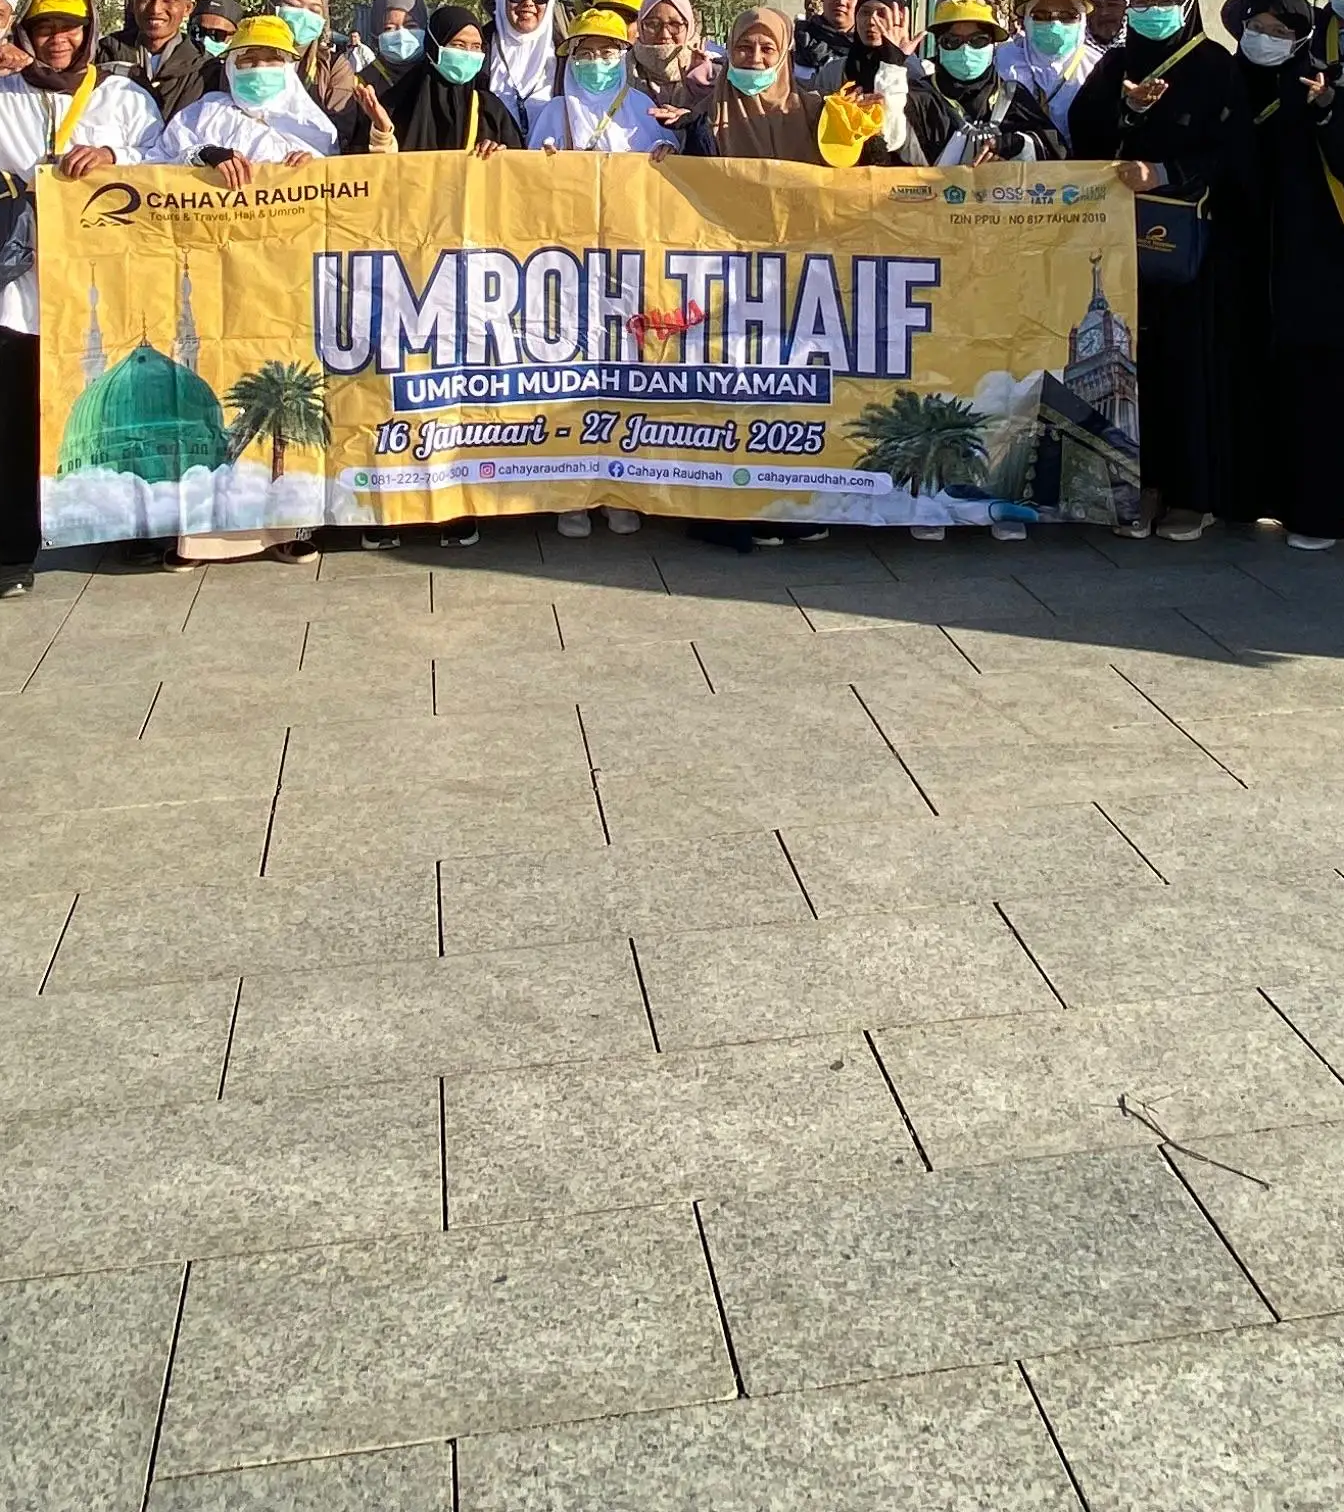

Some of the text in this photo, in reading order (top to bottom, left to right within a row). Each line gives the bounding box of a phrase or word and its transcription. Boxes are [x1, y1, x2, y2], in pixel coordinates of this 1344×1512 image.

[146, 180, 370, 209] CAHAYA RAUDHAH
[1030, 196, 1055, 205] IATA
[149, 211, 181, 222] Tours
[268, 205, 306, 219] Umroh
[950, 214, 972, 225] IZIN
[974, 214, 1001, 225] PPIU
[1009, 214, 1025, 225] NO
[1047, 213, 1080, 224] TAHUN
[313, 247, 942, 381] UMROH THAIF
[406, 368, 817, 404] UMROH MUDAH DAN NYAMAN
[375, 409, 826, 461] 16 Januaari - 27 Januari 2025
[497, 461, 601, 478] cahayaraudhah.id
[626, 464, 670, 480] Cahaya
[672, 466, 723, 482] Raudhah
[757, 471, 875, 488] cahayaraudhah.com
